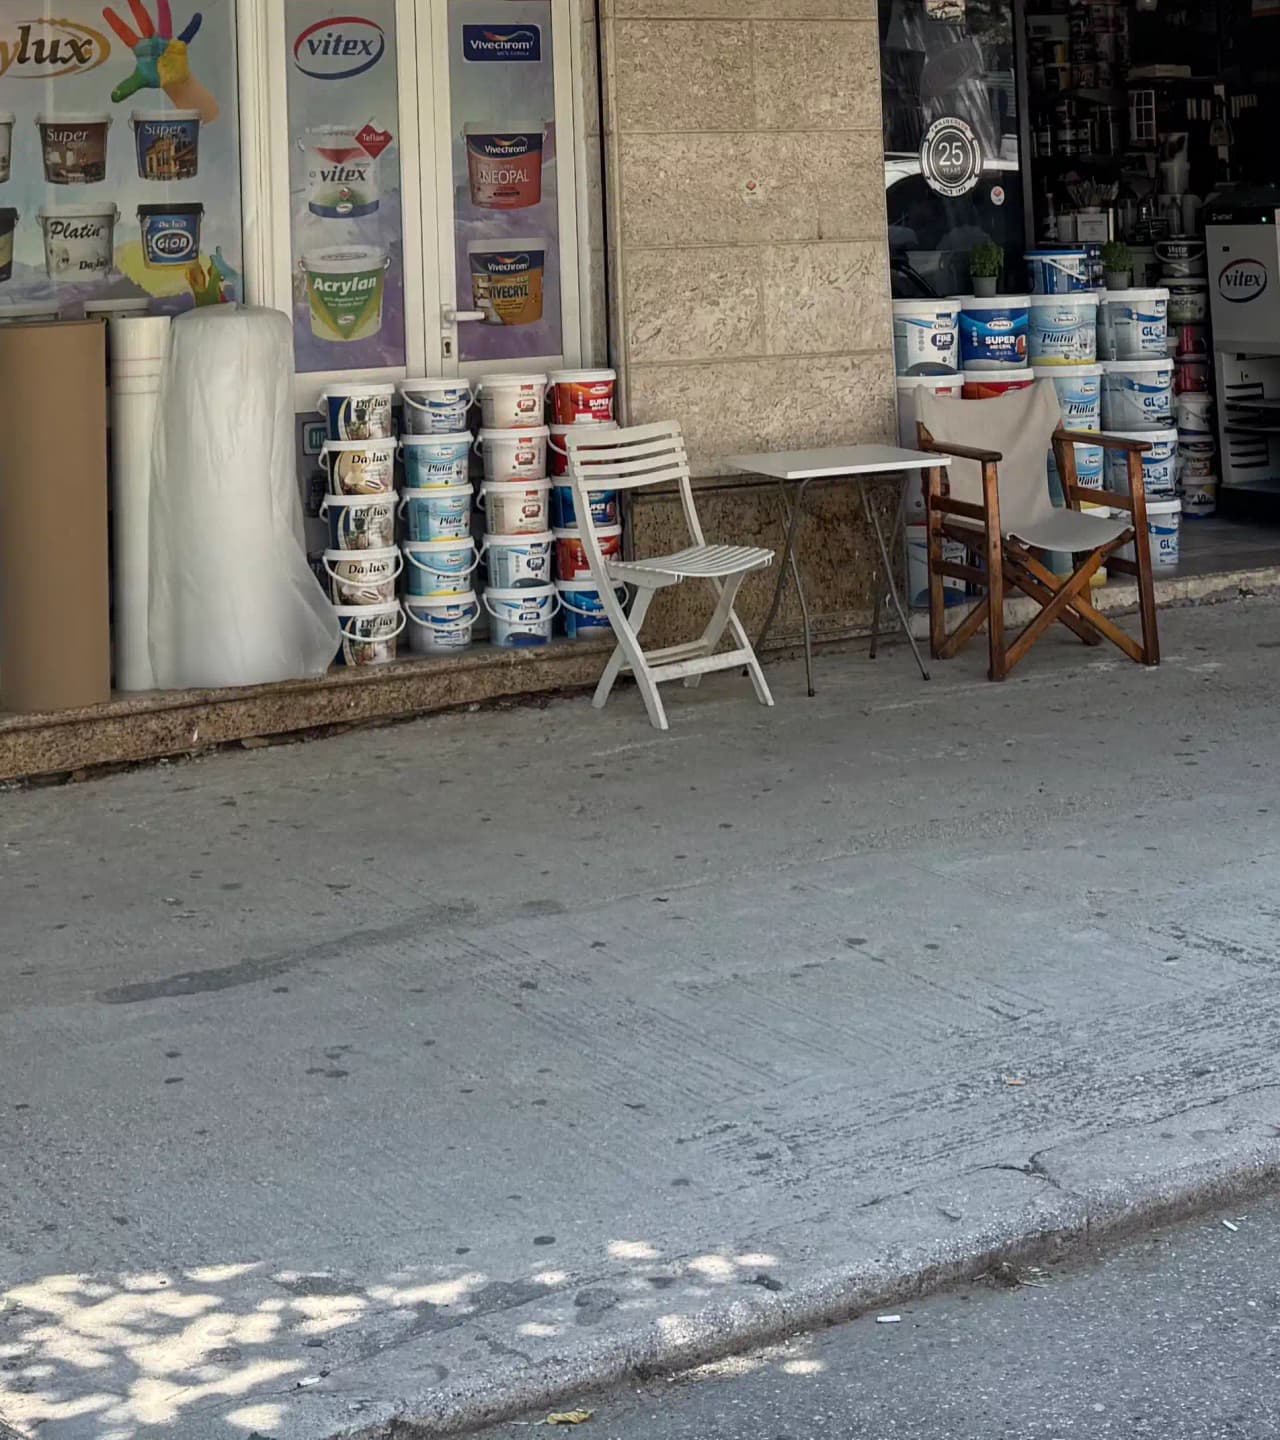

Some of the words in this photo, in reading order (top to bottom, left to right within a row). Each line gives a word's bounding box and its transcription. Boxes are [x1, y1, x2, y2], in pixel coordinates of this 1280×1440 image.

[306, 33, 373, 57] vitex
[470, 39, 530, 51] Vivechrom
[47, 127, 88, 144] Super
[144, 123, 182, 139] Super
[938, 142, 964, 166] 25
[320, 165, 367, 182] vitex
[50, 221, 101, 241] Platin
[313, 275, 377, 297] Acrylan
[1225, 270, 1261, 287] vitex
[985, 335, 1016, 345] SUPER
